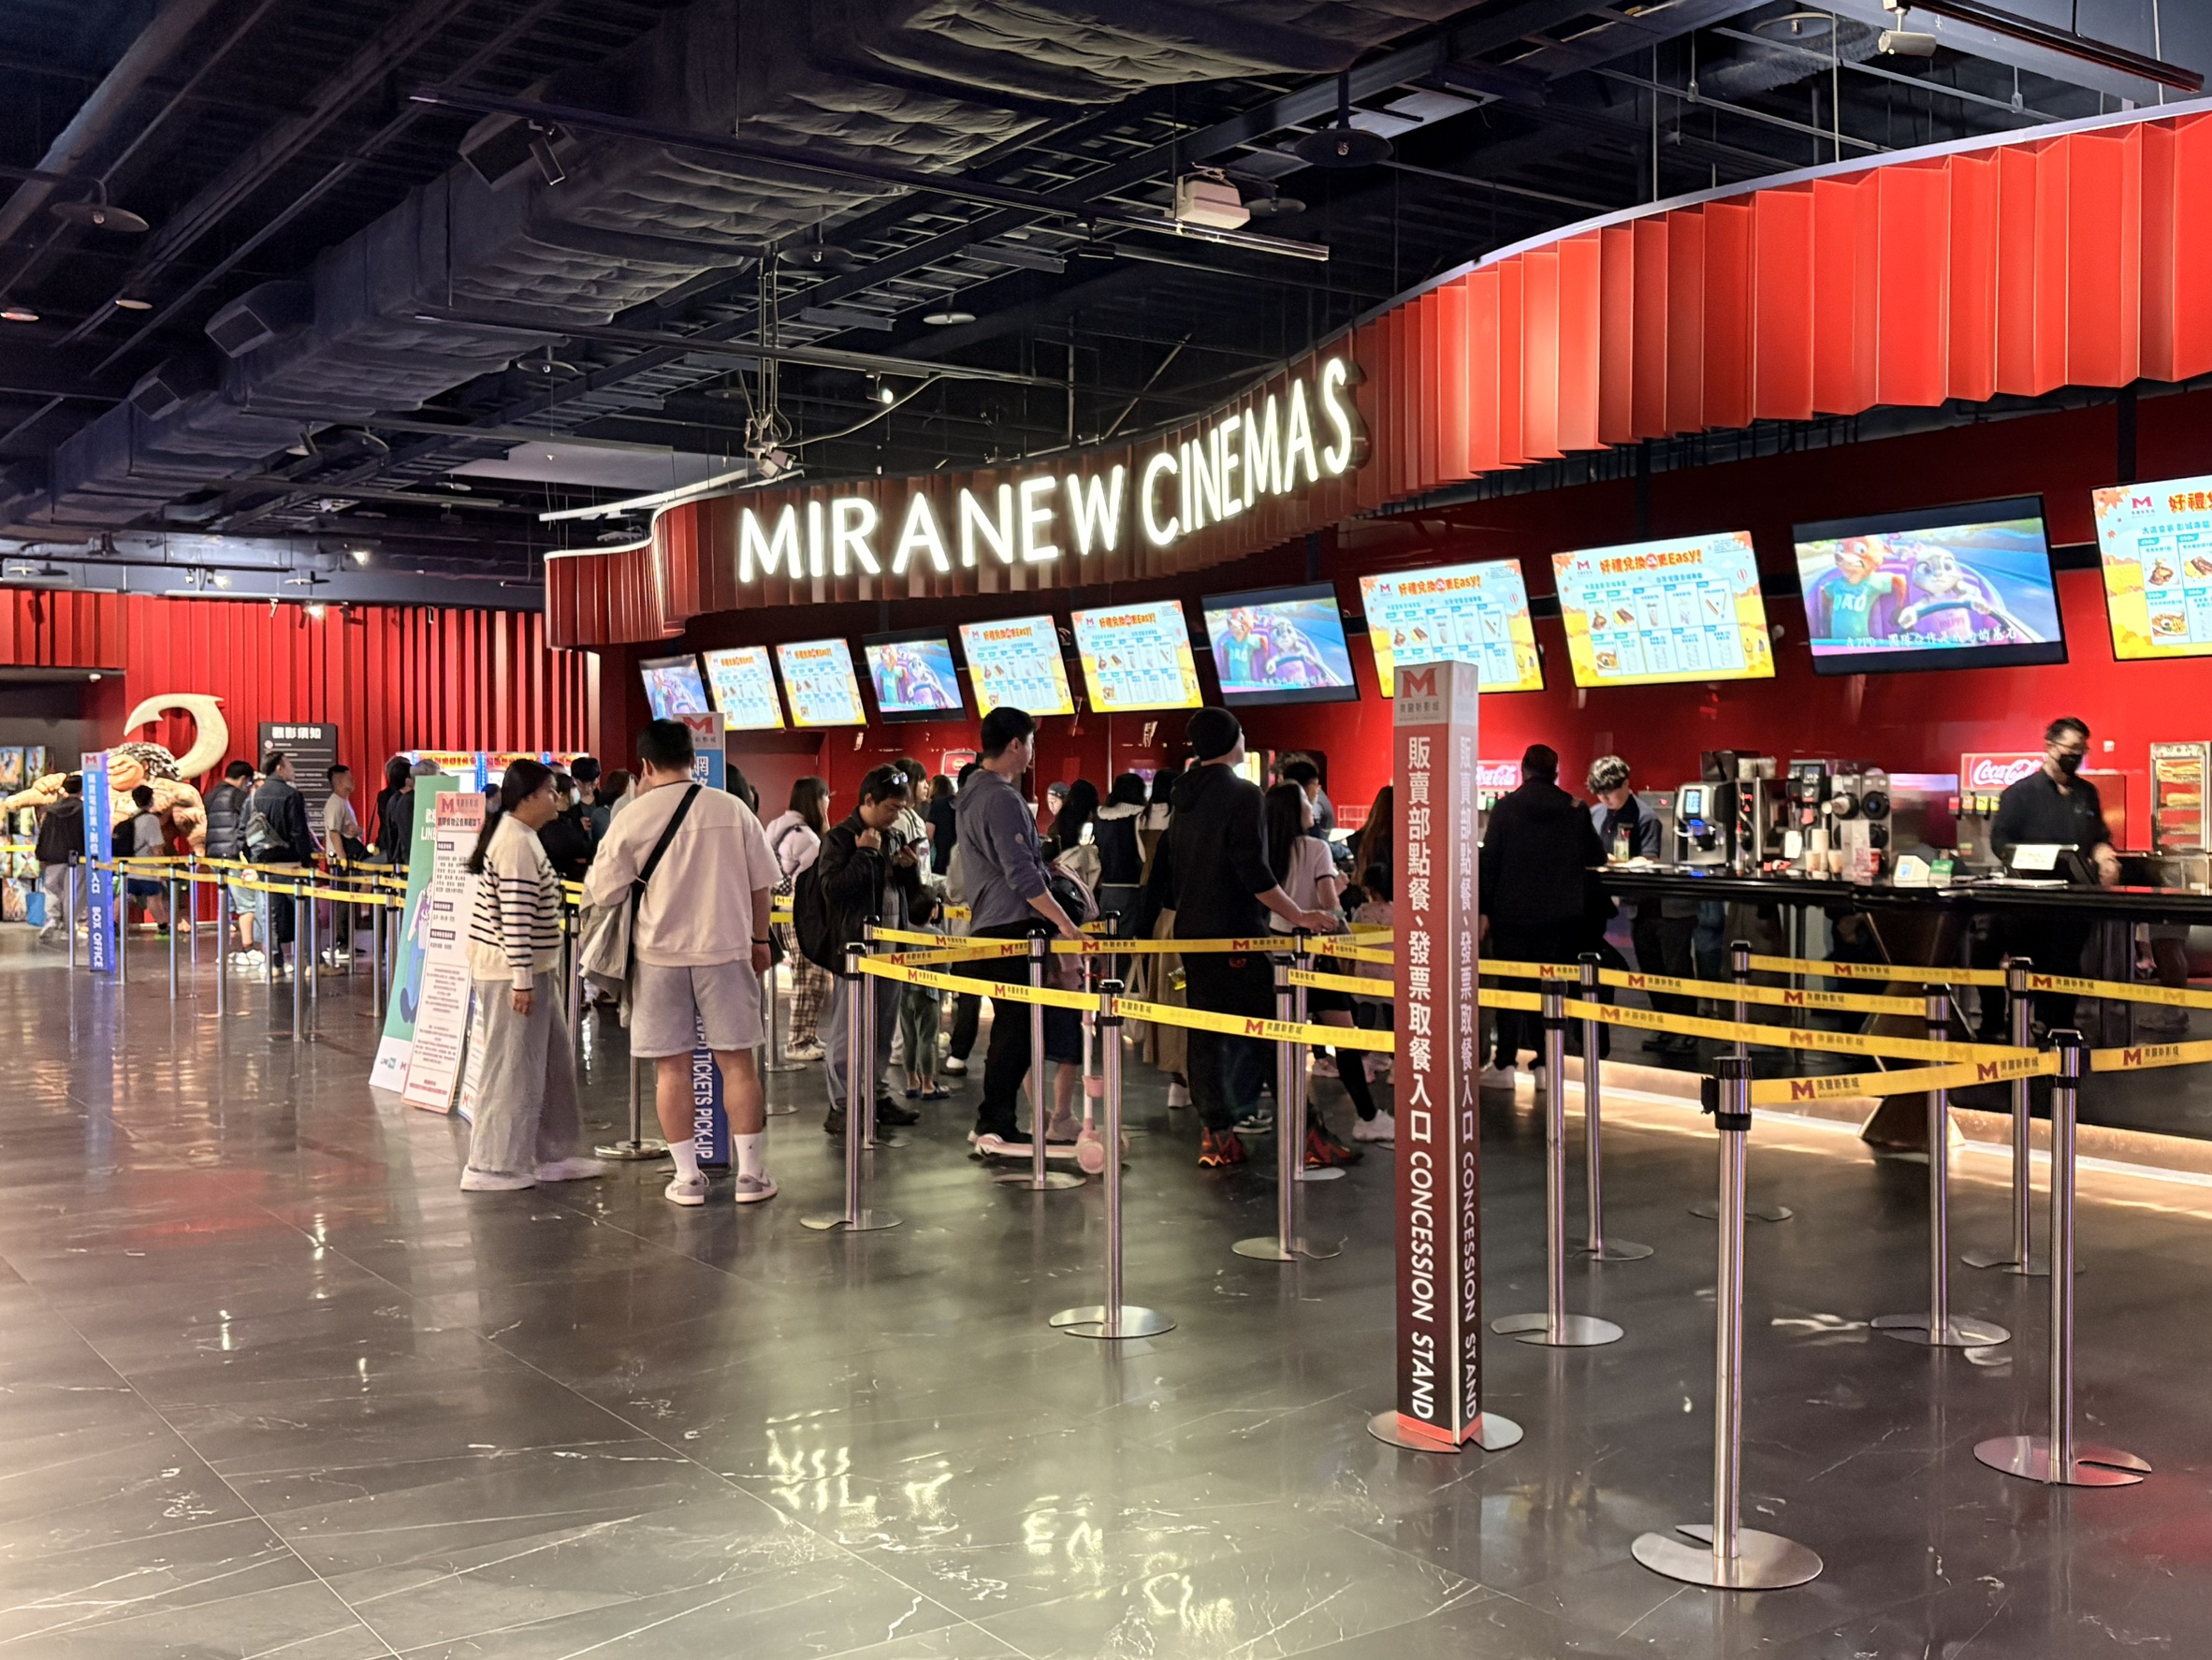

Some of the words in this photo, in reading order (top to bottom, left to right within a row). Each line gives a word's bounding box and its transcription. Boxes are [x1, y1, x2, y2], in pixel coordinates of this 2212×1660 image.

[738, 464, 1125, 583] MIRANEW
[1141, 357, 1354, 546] CINEMAS
[2168, 492, 2212, 513] 好禮
[1401, 667, 1438, 699] M
[1972, 759, 2045, 786] Coca-Col
[441, 798, 455, 813] M
[92, 906, 102, 929] BOX
[93, 931, 104, 968] OFFICE
[1083, 941, 1099, 952] M
[1232, 940, 1250, 950] M
[891, 954, 905, 965] M
[1539, 966, 1554, 978] M
[1834, 964, 1852, 976] M
[1628, 974, 1645, 988] M
[2032, 975, 2053, 989] M
[1783, 990, 1804, 1005] M
[1600, 1006, 1621, 1022] M
[1244, 1019, 1265, 1036] M
[1790, 1030, 1813, 1047] M
[2122, 1048, 2142, 1066] M
[692, 1052, 713, 1106] TICKETS
[1976, 1061, 2000, 1082] M
[1790, 1080, 1815, 1100] M
[694, 1108, 713, 1159] PICK-UP
[1410, 1151, 1433, 1322] CONCESSION
[1463, 1152, 1476, 1322] CONCESSION
[1412, 1332, 1434, 1420] STAND
[1464, 1332, 1477, 1420] STAND
